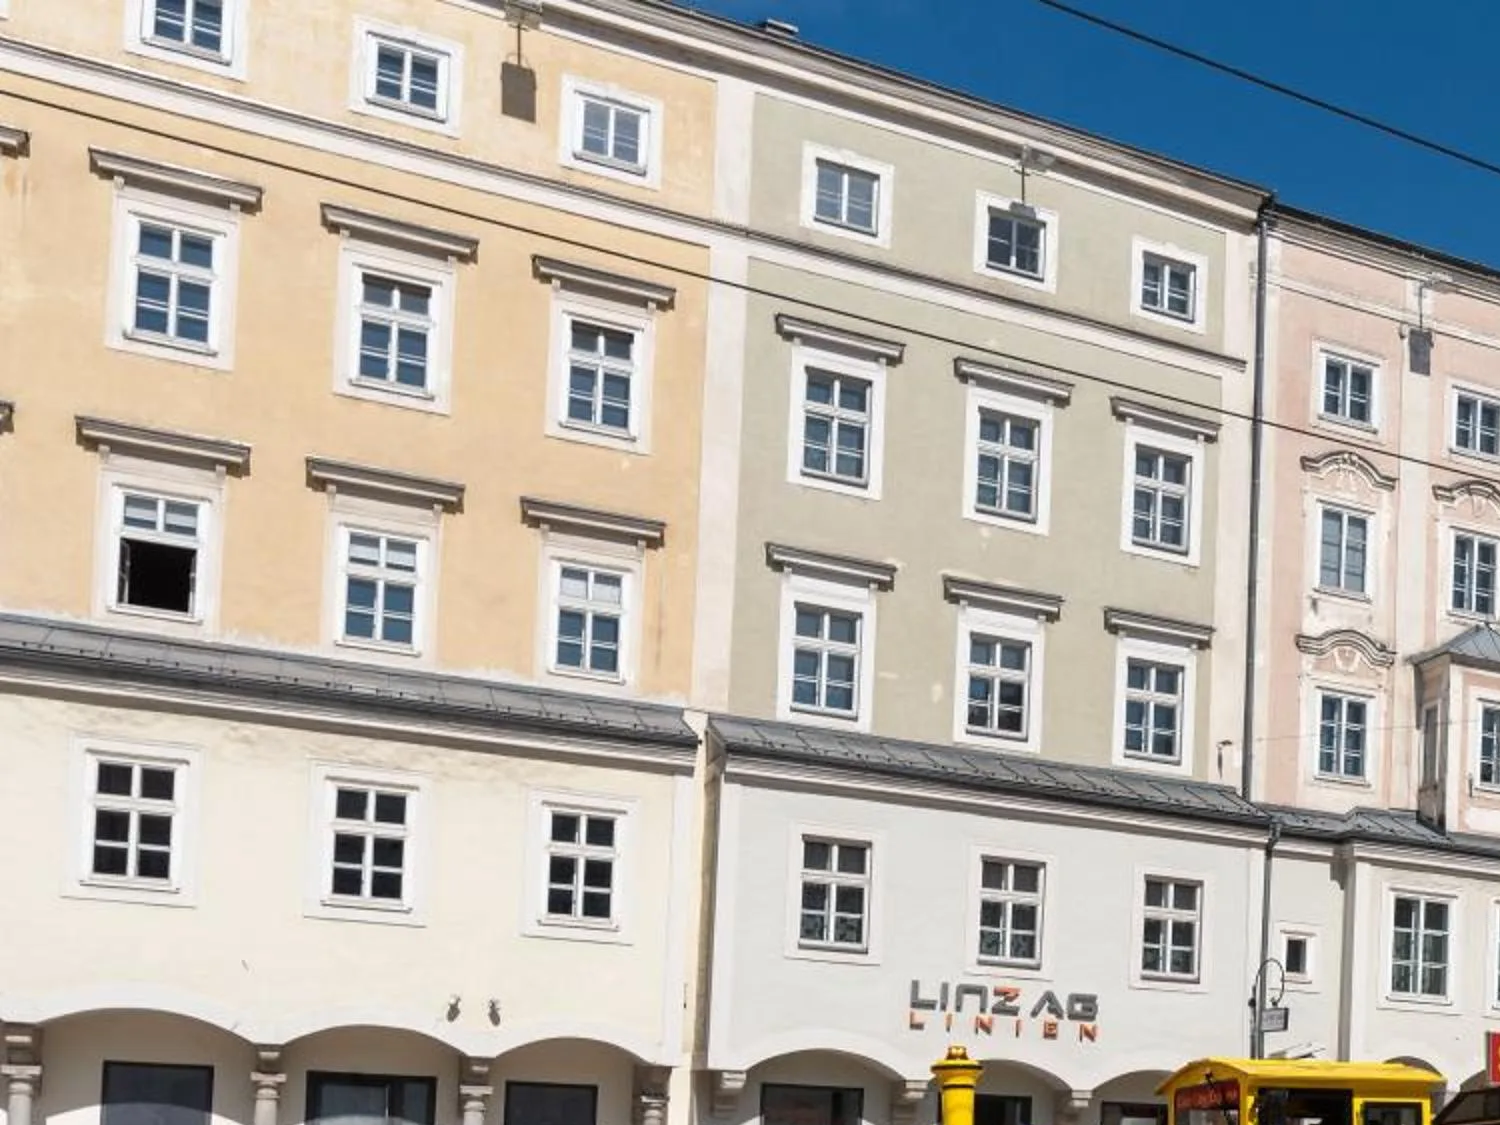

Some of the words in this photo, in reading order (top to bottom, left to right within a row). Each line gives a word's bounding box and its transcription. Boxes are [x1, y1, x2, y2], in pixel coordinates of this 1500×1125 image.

[910, 980, 1021, 1016] LINZ
[1030, 990, 1098, 1022] AG
[909, 1012, 1098, 1042] LINIEN
